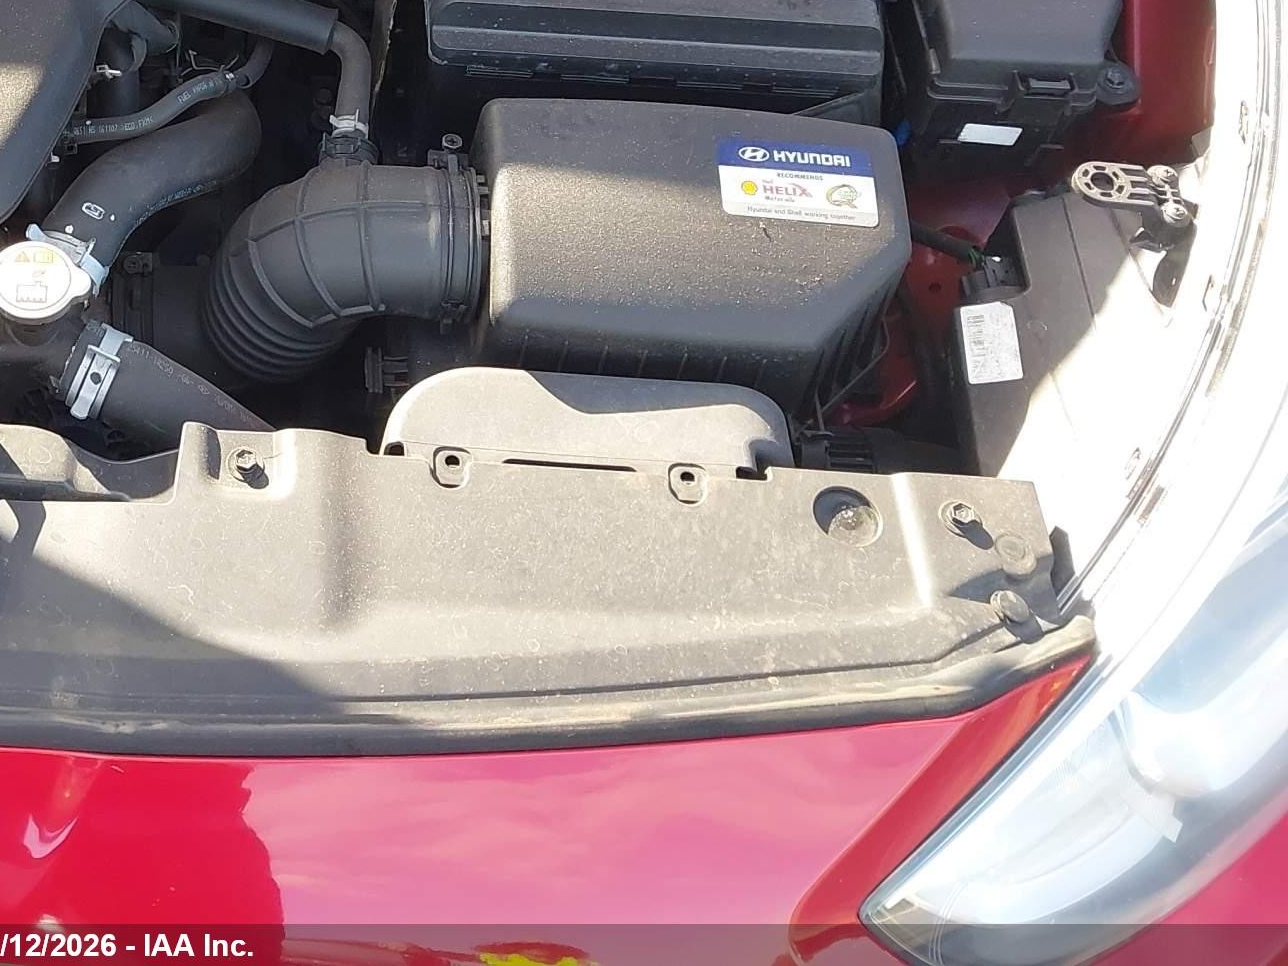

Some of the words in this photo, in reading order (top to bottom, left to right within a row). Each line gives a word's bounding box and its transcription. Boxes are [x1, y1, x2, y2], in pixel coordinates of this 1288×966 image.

[177, 90, 192, 104] FUEL
[773, 150, 851, 167] HYUNDAI
[776, 172, 824, 181] RECOMMENDS
[762, 183, 810, 198] HELIX
[747, 206, 772, 214] Hyundai
[787, 208, 802, 216] Shell
[804, 211, 829, 220] working
[830, 213, 856, 221] together
